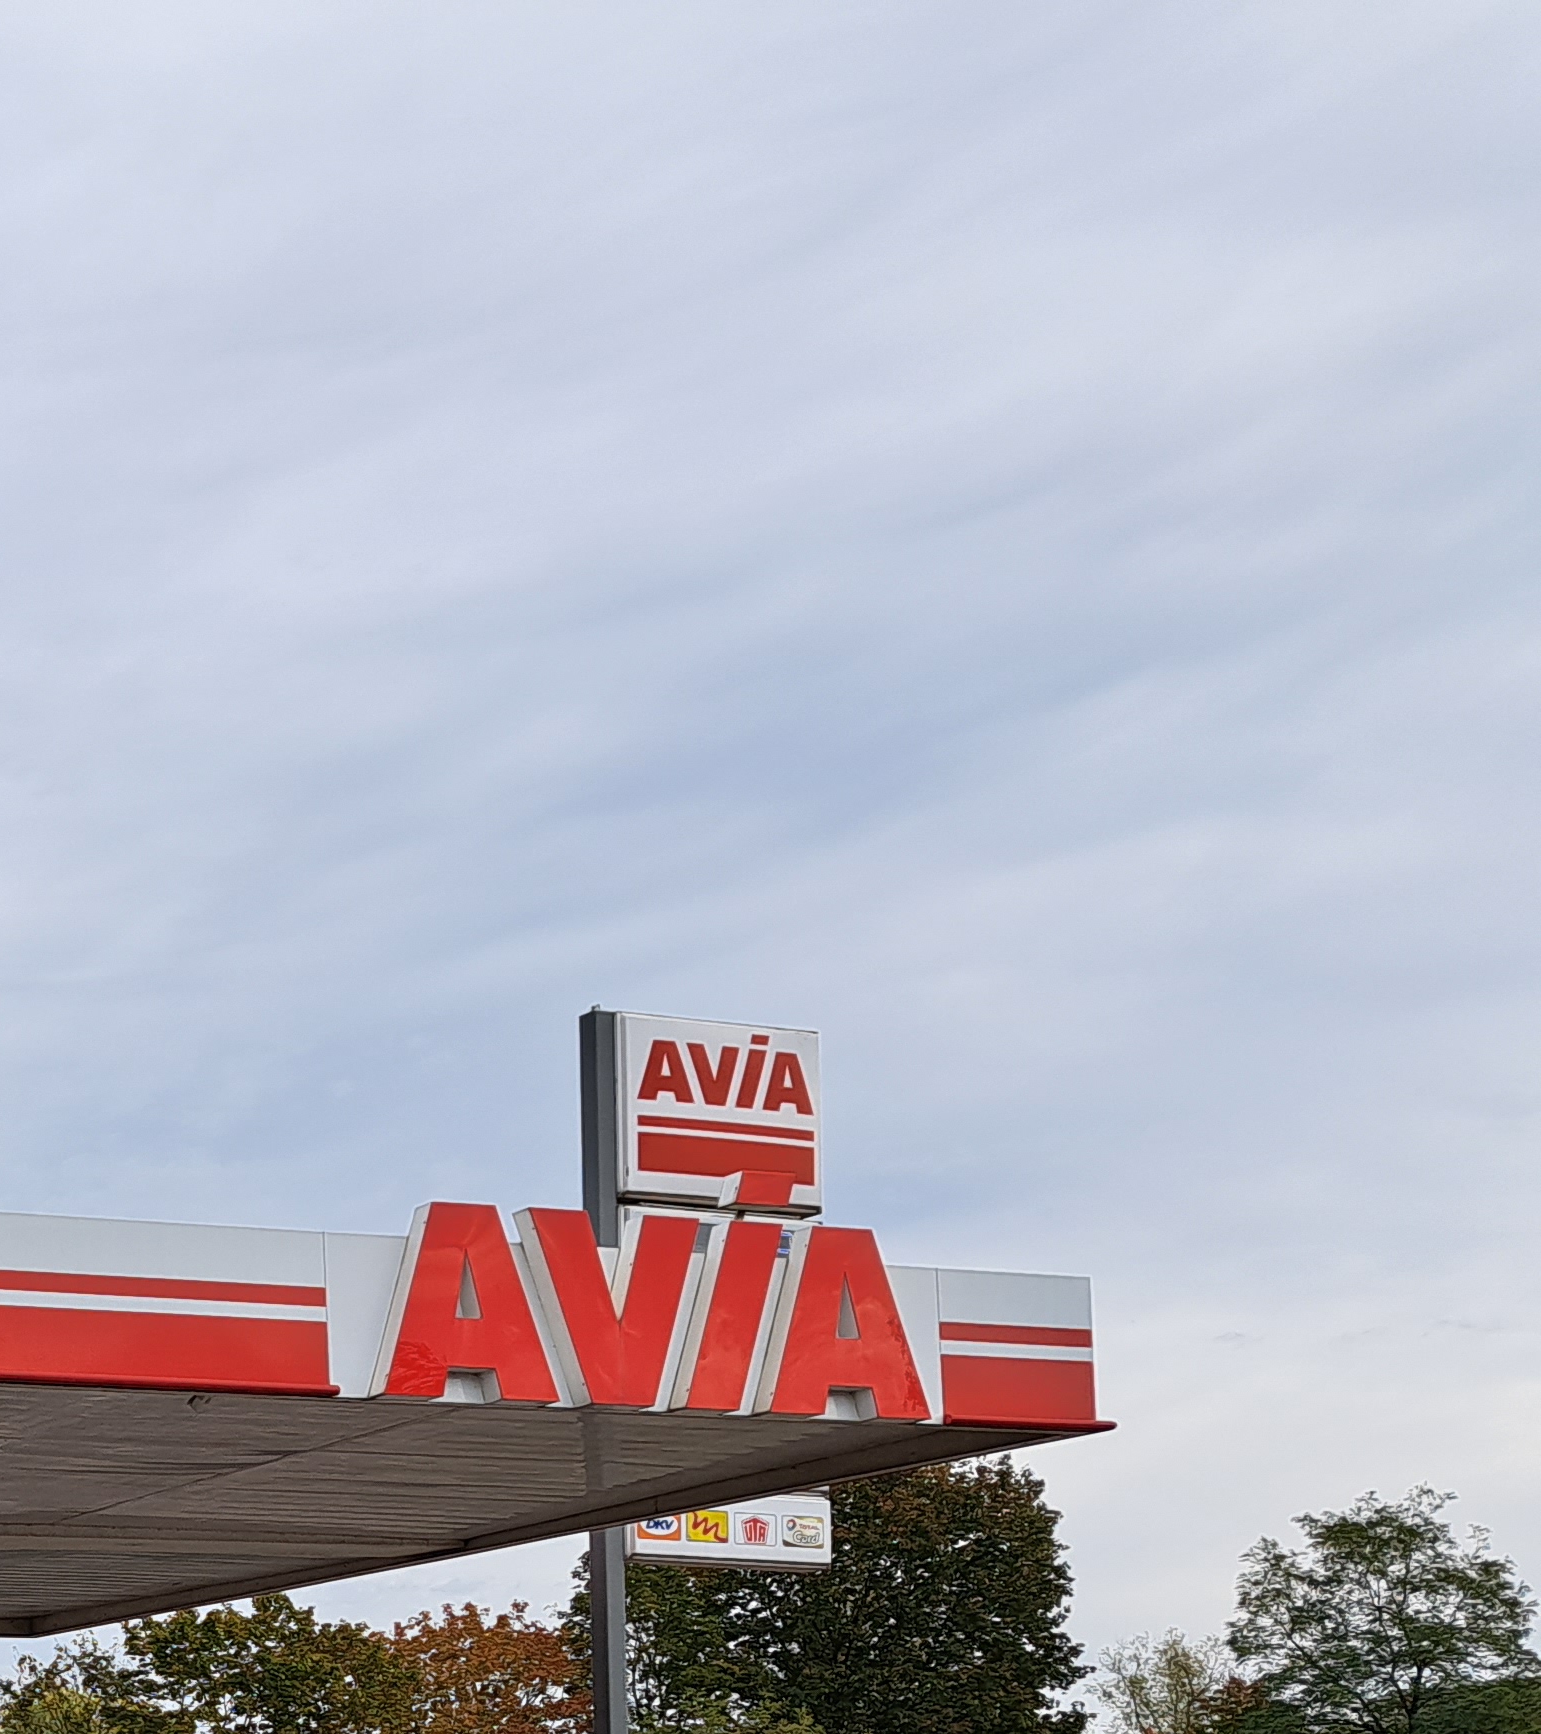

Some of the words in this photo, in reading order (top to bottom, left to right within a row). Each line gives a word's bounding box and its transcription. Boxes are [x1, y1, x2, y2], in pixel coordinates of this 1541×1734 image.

[646, 1519, 674, 1531] DKV
[743, 1517, 768, 1543] UTA
[793, 1531, 821, 1545] Card
